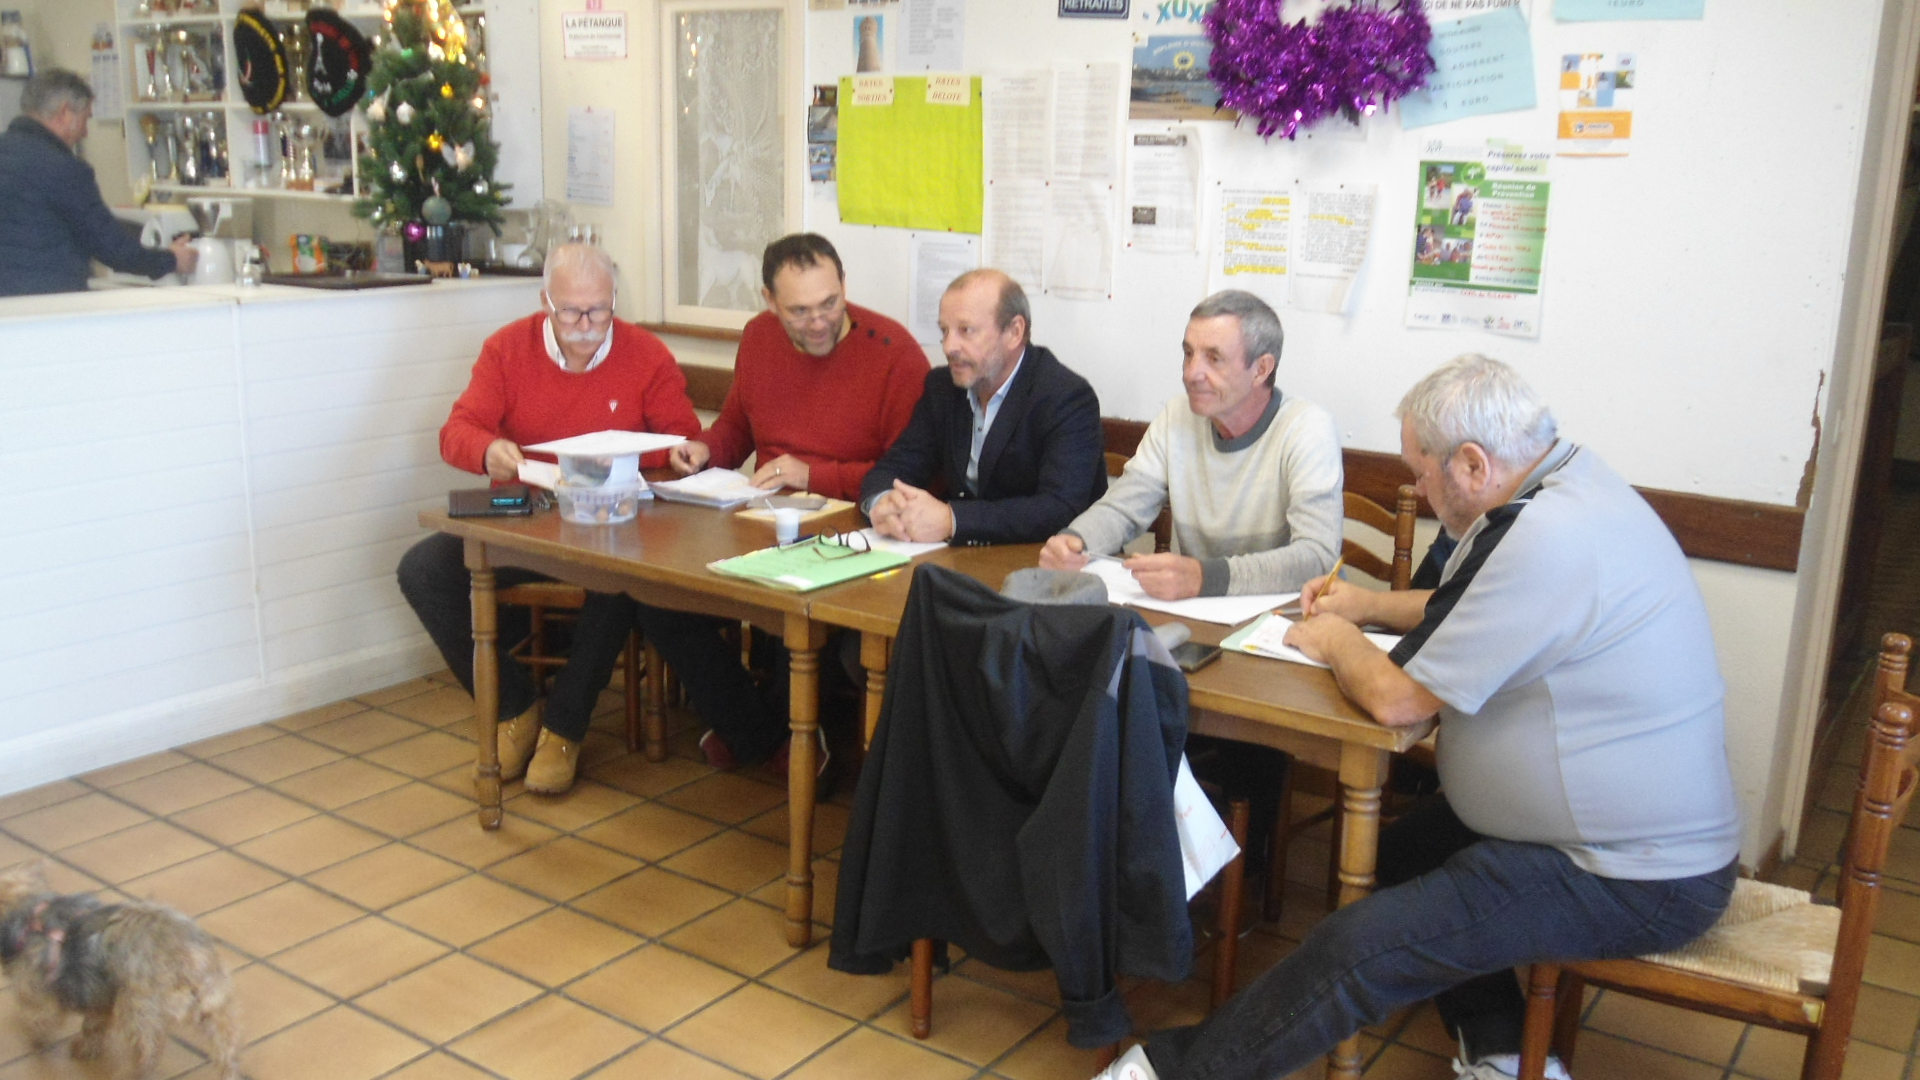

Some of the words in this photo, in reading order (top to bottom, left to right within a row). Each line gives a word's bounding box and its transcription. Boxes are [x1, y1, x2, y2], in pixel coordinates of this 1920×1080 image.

[1451, 0, 1463, 9] NE
[1466, 0, 1485, 9] PAS
[565, 18, 577, 28] LA
[578, 15, 623, 28] PÉTANQUE
[1452, 53, 1505, 70] ADHERENT
[1487, 149, 1528, 160] Préservez
[1530, 150, 1551, 160] votre
[1486, 164, 1514, 173] capital
[1514, 164, 1538, 173] santé
